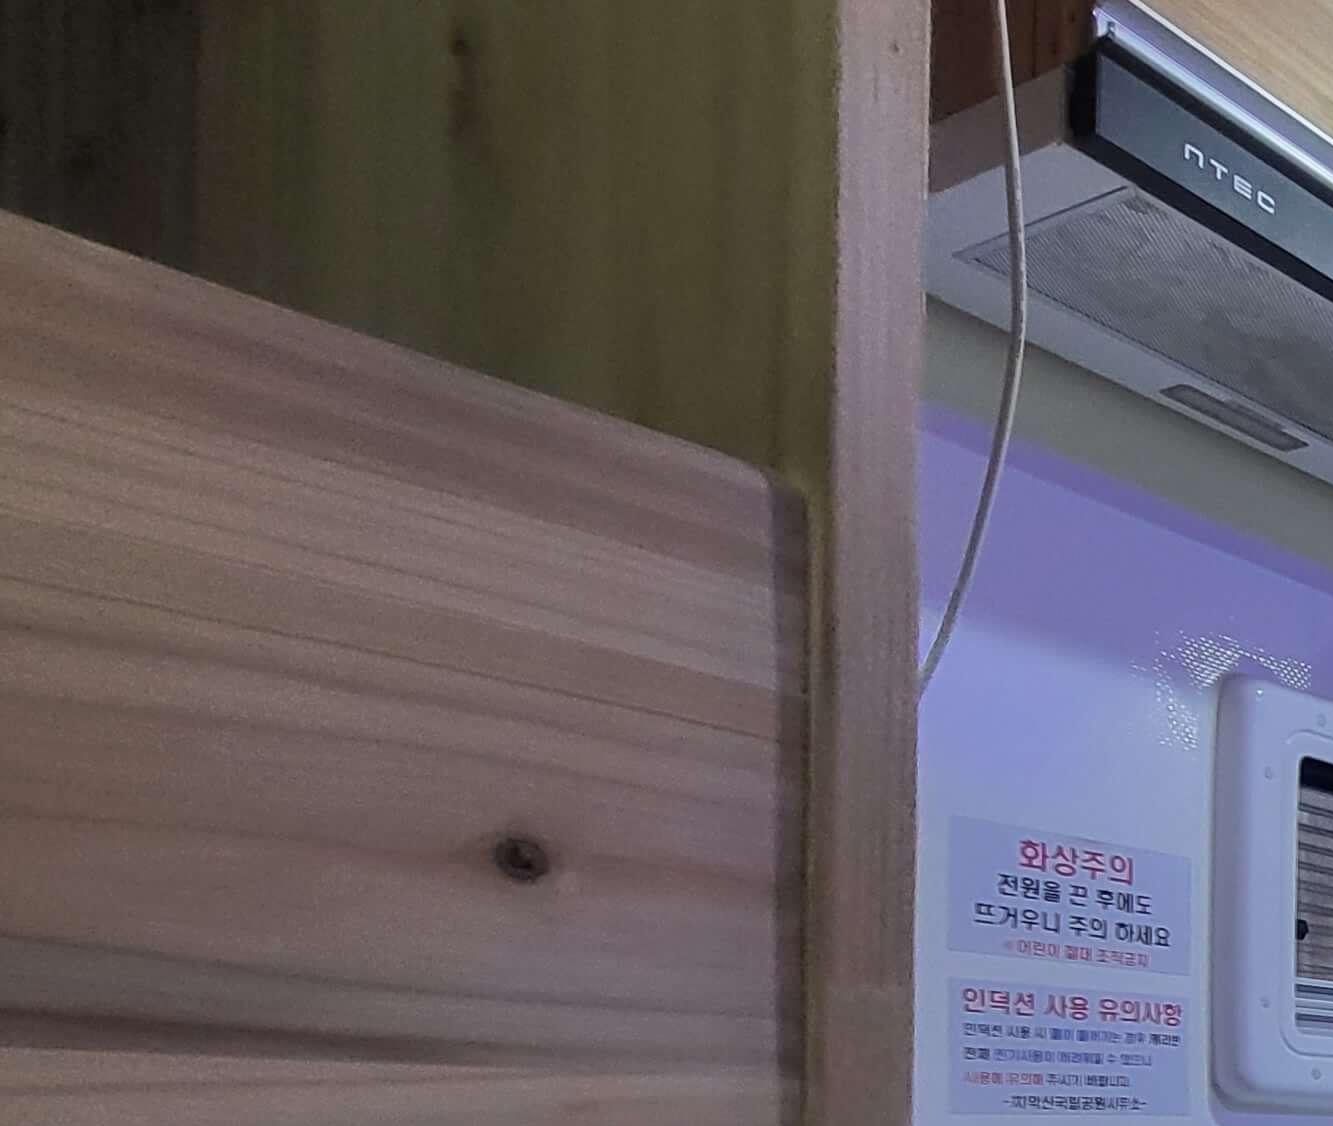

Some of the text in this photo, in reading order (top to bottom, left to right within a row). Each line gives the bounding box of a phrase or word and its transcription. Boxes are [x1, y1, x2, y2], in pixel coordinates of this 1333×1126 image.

[1018, 840, 1133, 885] 화상주의
[997, 873, 1153, 915] 전원을 끈 후에도
[973, 902, 1170, 947] 뜨거우니 주의 하세요
[961, 987, 1183, 1028] 인덕션 사용 유의사항
